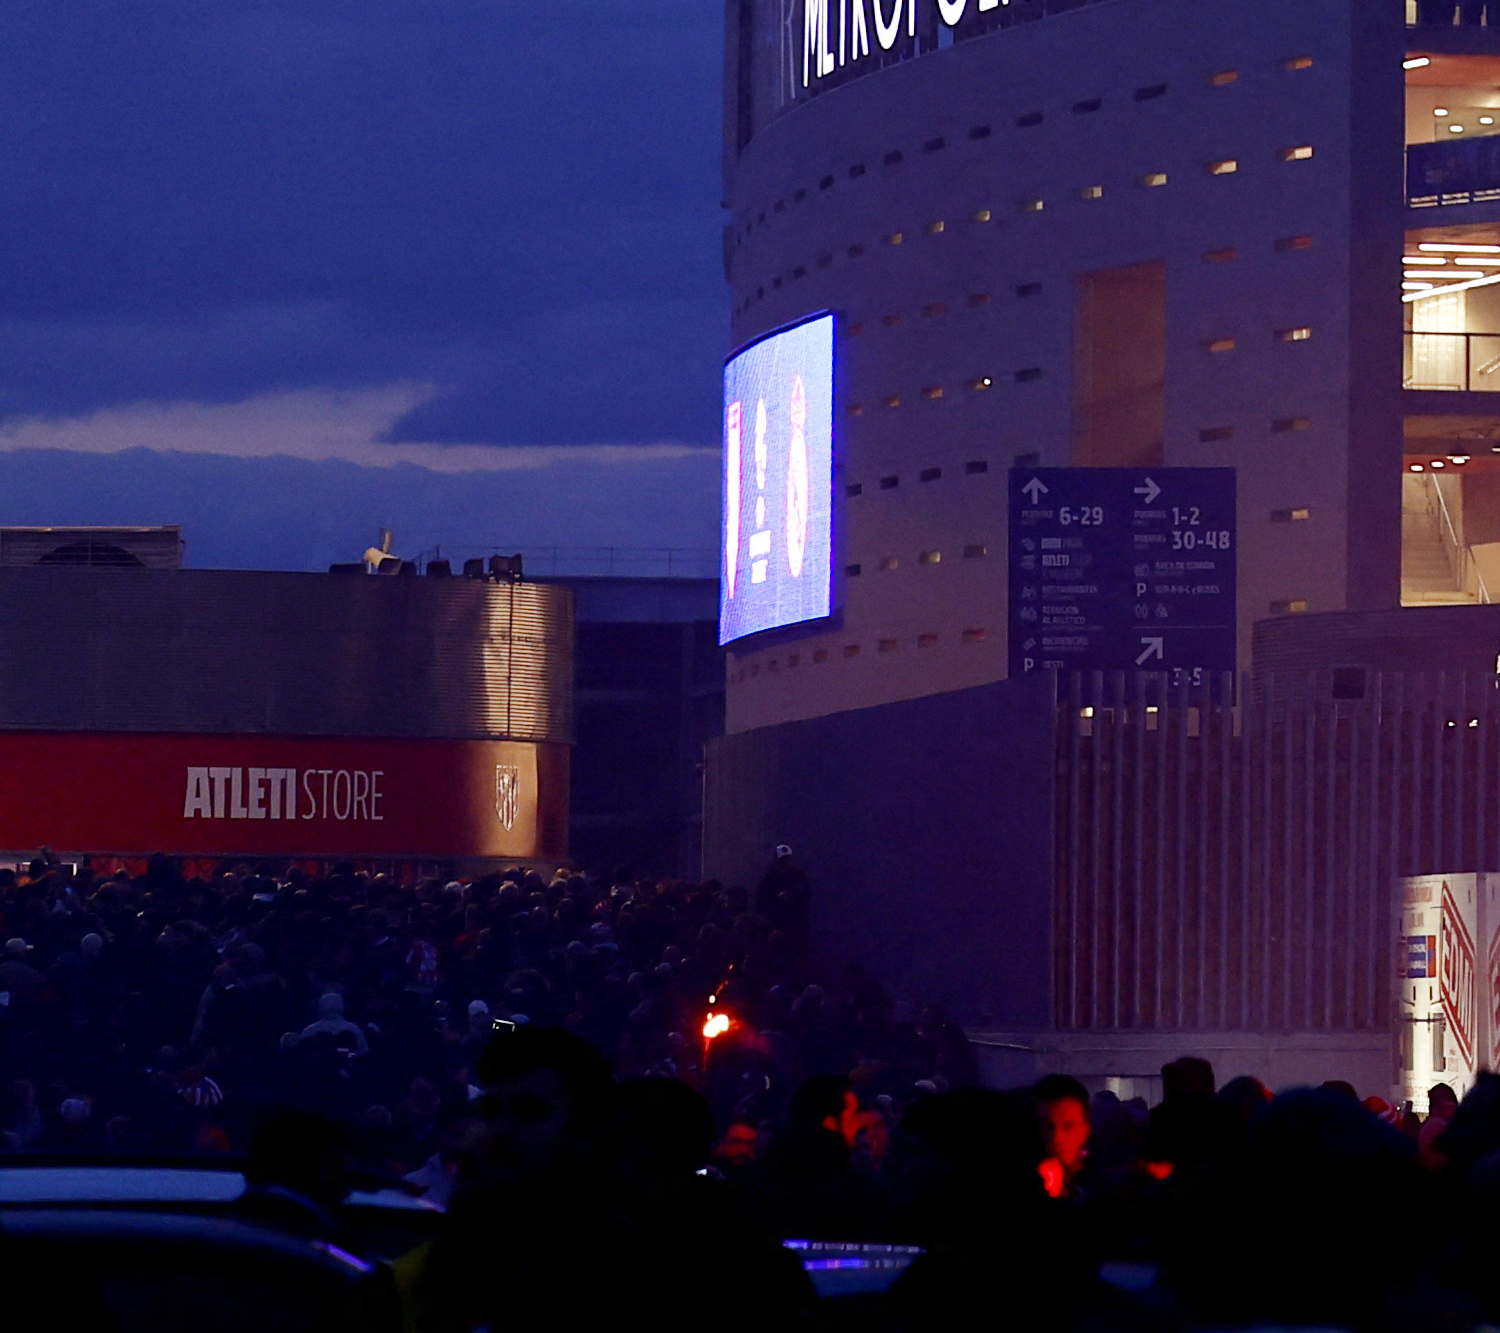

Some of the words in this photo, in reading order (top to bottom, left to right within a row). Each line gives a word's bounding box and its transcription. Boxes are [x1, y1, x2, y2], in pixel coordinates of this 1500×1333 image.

[1059, 506, 1104, 526] 6-29
[1172, 506, 1201, 526] 1-2
[1172, 530, 1231, 550] 30-48
[1024, 657, 1035, 673] P
[1441, 916, 1473, 1043] EDMI
